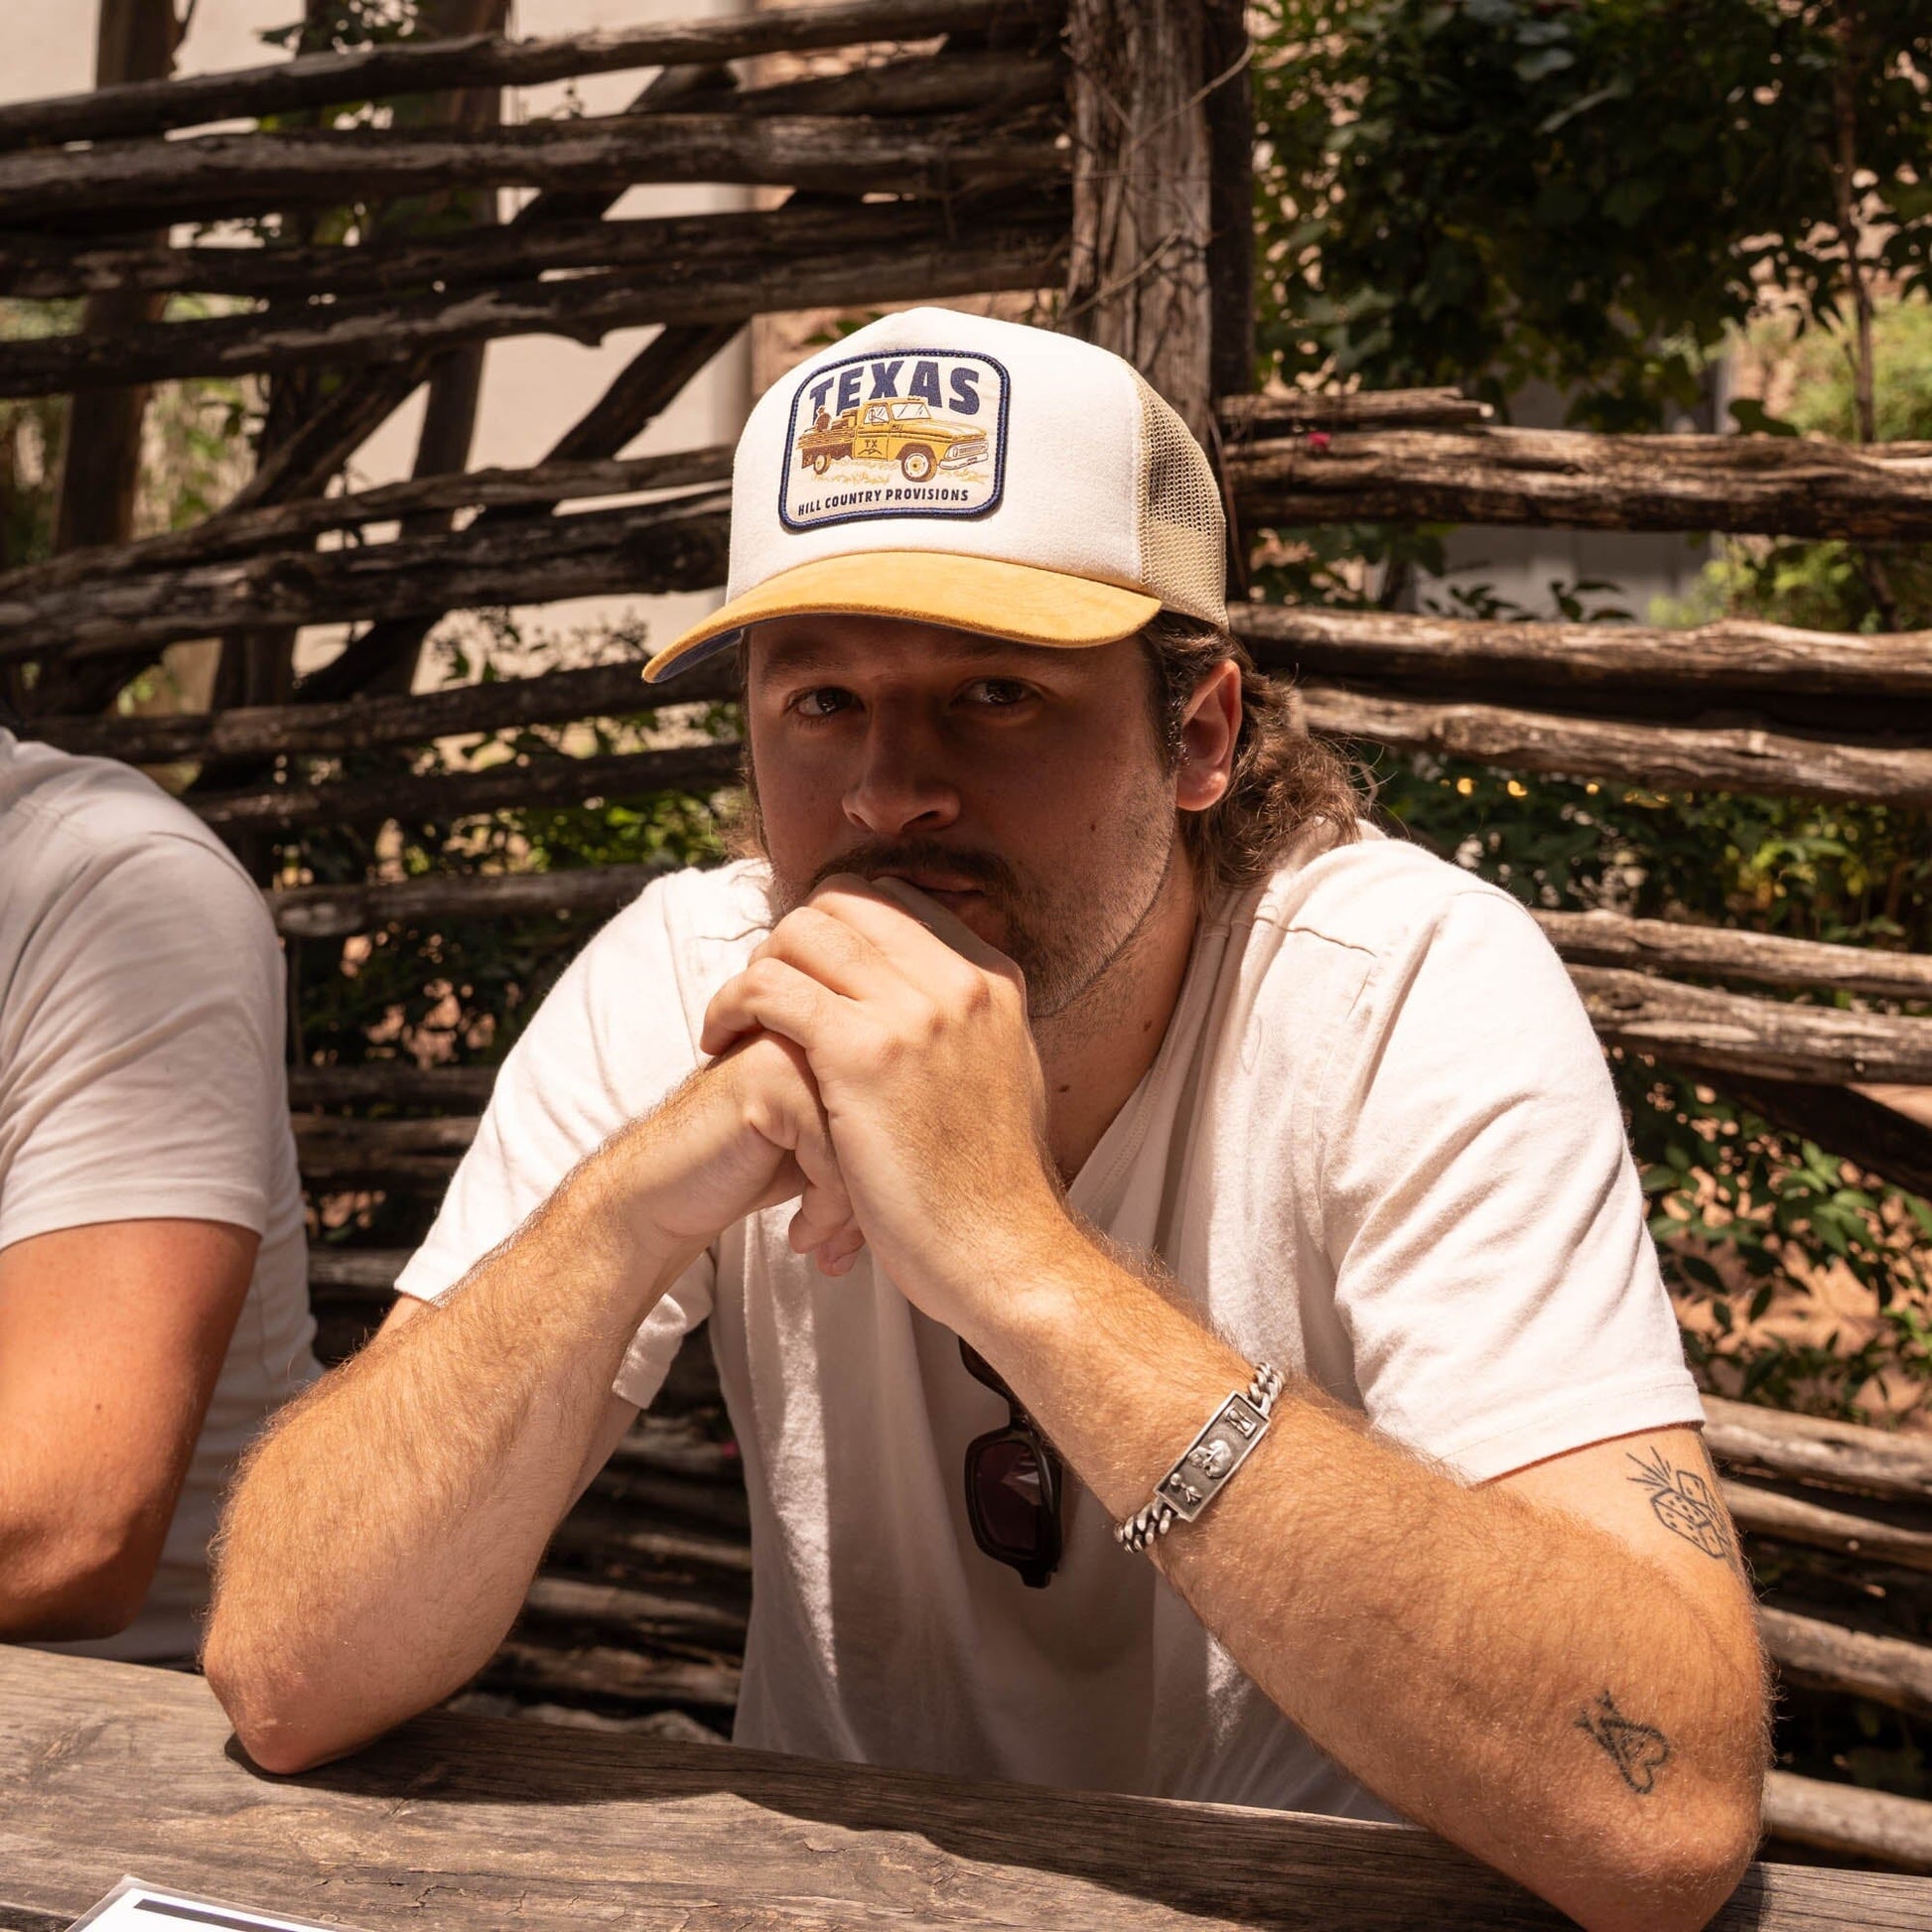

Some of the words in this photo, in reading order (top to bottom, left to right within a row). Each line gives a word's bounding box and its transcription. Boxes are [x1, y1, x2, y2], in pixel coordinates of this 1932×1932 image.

[808, 360, 980, 424] TEXAS
[798, 500, 821, 516] HILL
[825, 489, 882, 508] COUNTRY
[886, 487, 969, 501] PROVISIONS
